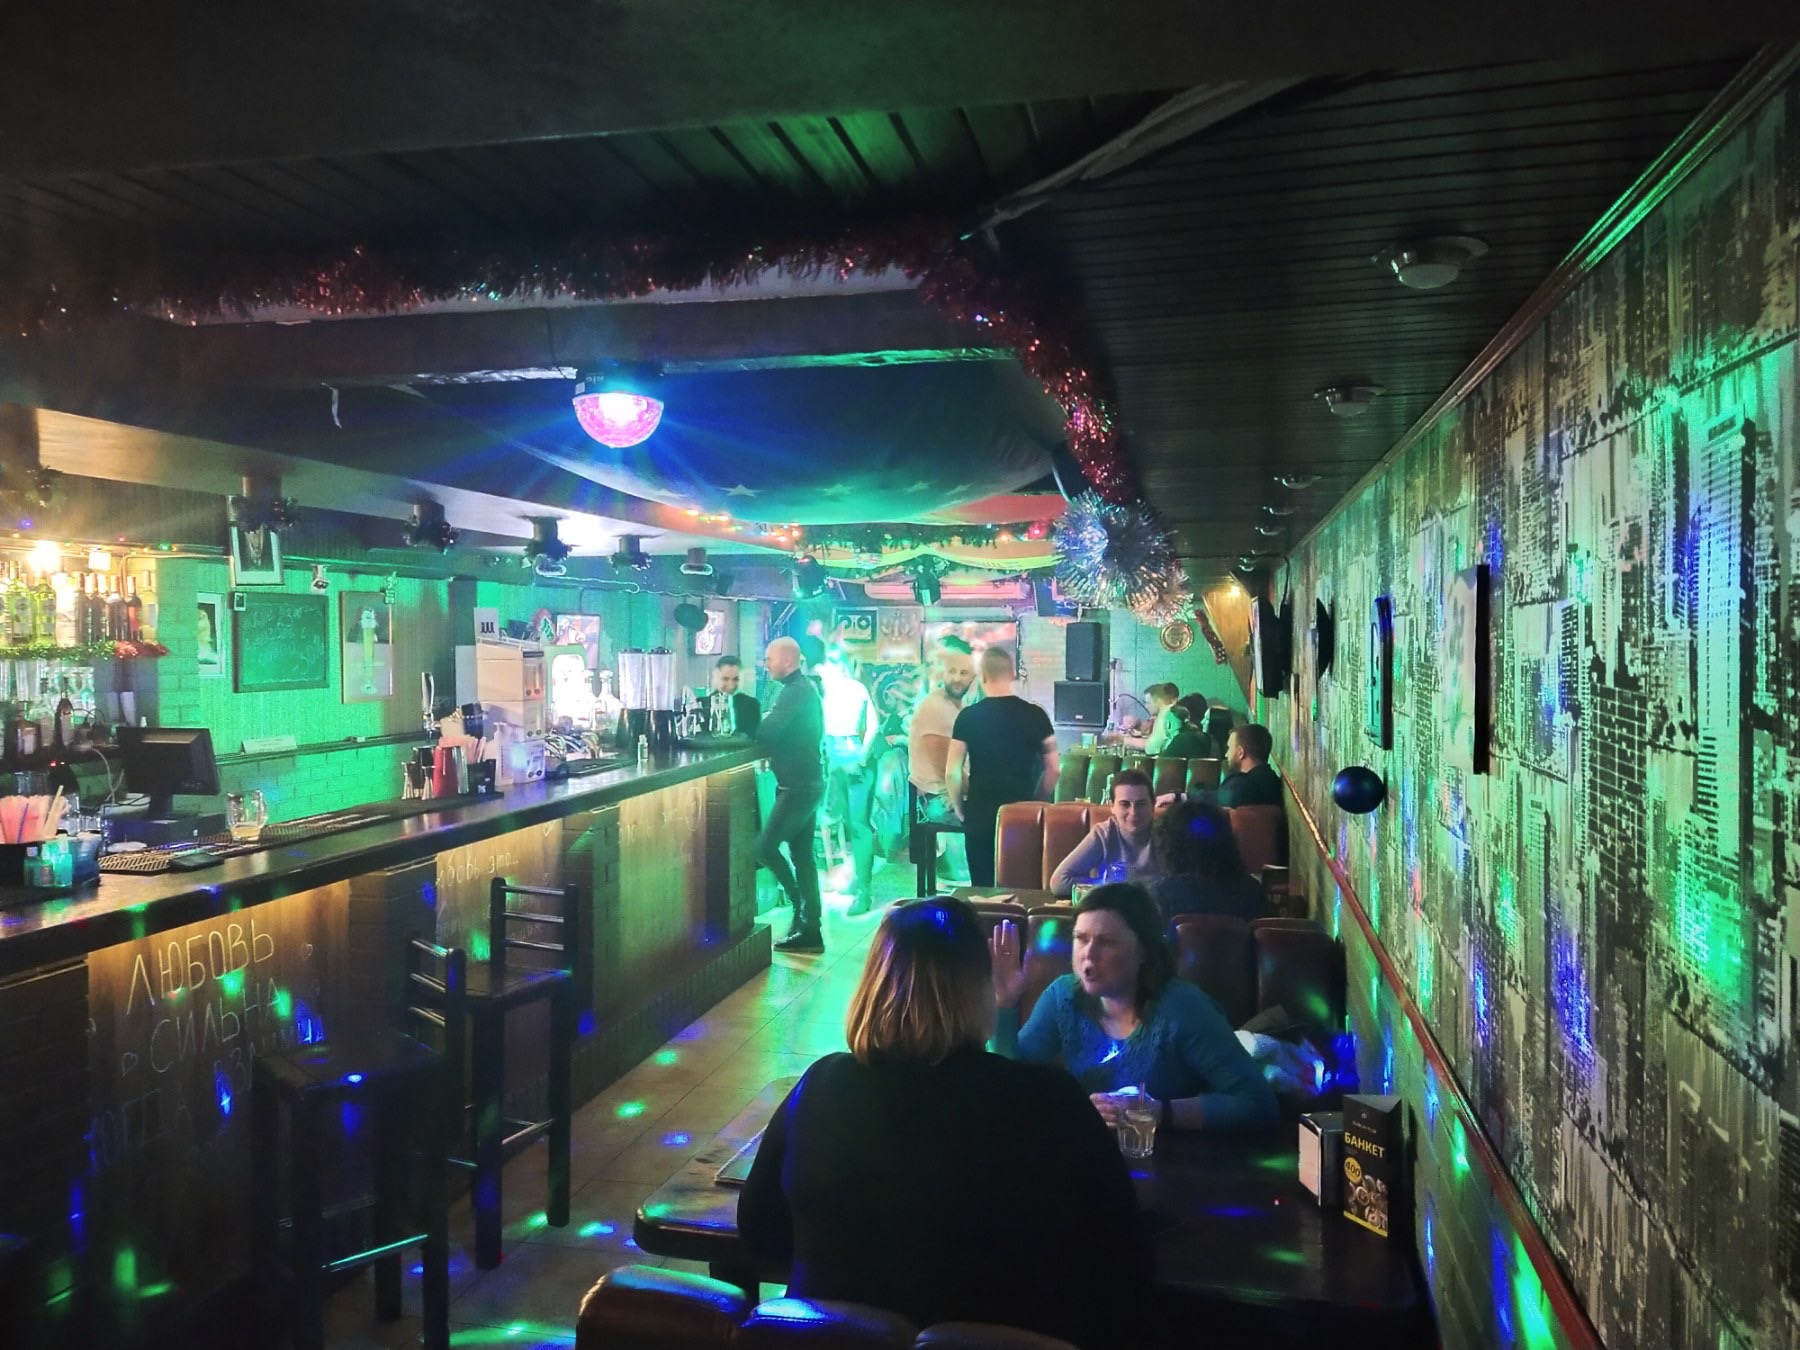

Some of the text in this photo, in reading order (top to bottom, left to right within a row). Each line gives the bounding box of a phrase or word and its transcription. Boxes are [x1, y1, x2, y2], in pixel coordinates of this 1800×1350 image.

[126, 918, 274, 1016] ЛЮБОВЬ
[150, 977, 286, 1073] СИЛЬНА
[1344, 1131, 1384, 1158] БАНКЕТ
[1346, 1161, 1361, 1177] 400
